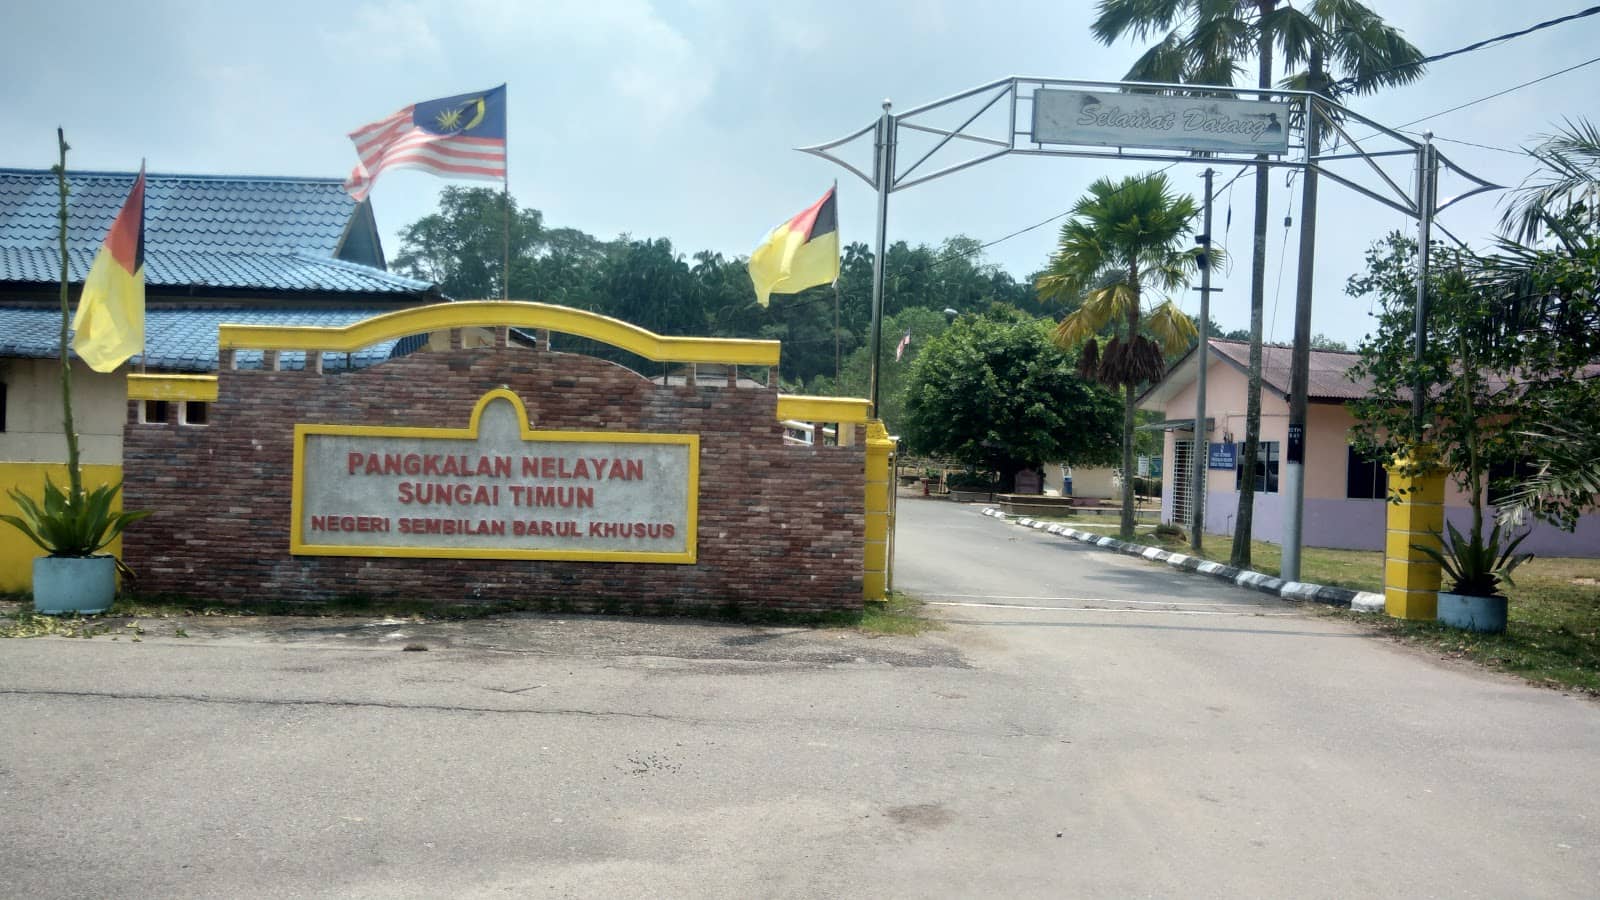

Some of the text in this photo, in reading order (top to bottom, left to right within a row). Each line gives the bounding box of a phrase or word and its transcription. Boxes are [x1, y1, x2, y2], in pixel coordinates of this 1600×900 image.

[1077, 103, 1266, 142] Selamat Datang
[348, 452, 644, 481] PANGKALAN NELAYAN
[398, 482, 595, 508] SUNGAI TIMUN
[311, 515, 390, 533] NEGERI
[399, 517, 505, 536] SEMBILAN
[589, 521, 675, 539] KHUSUS
